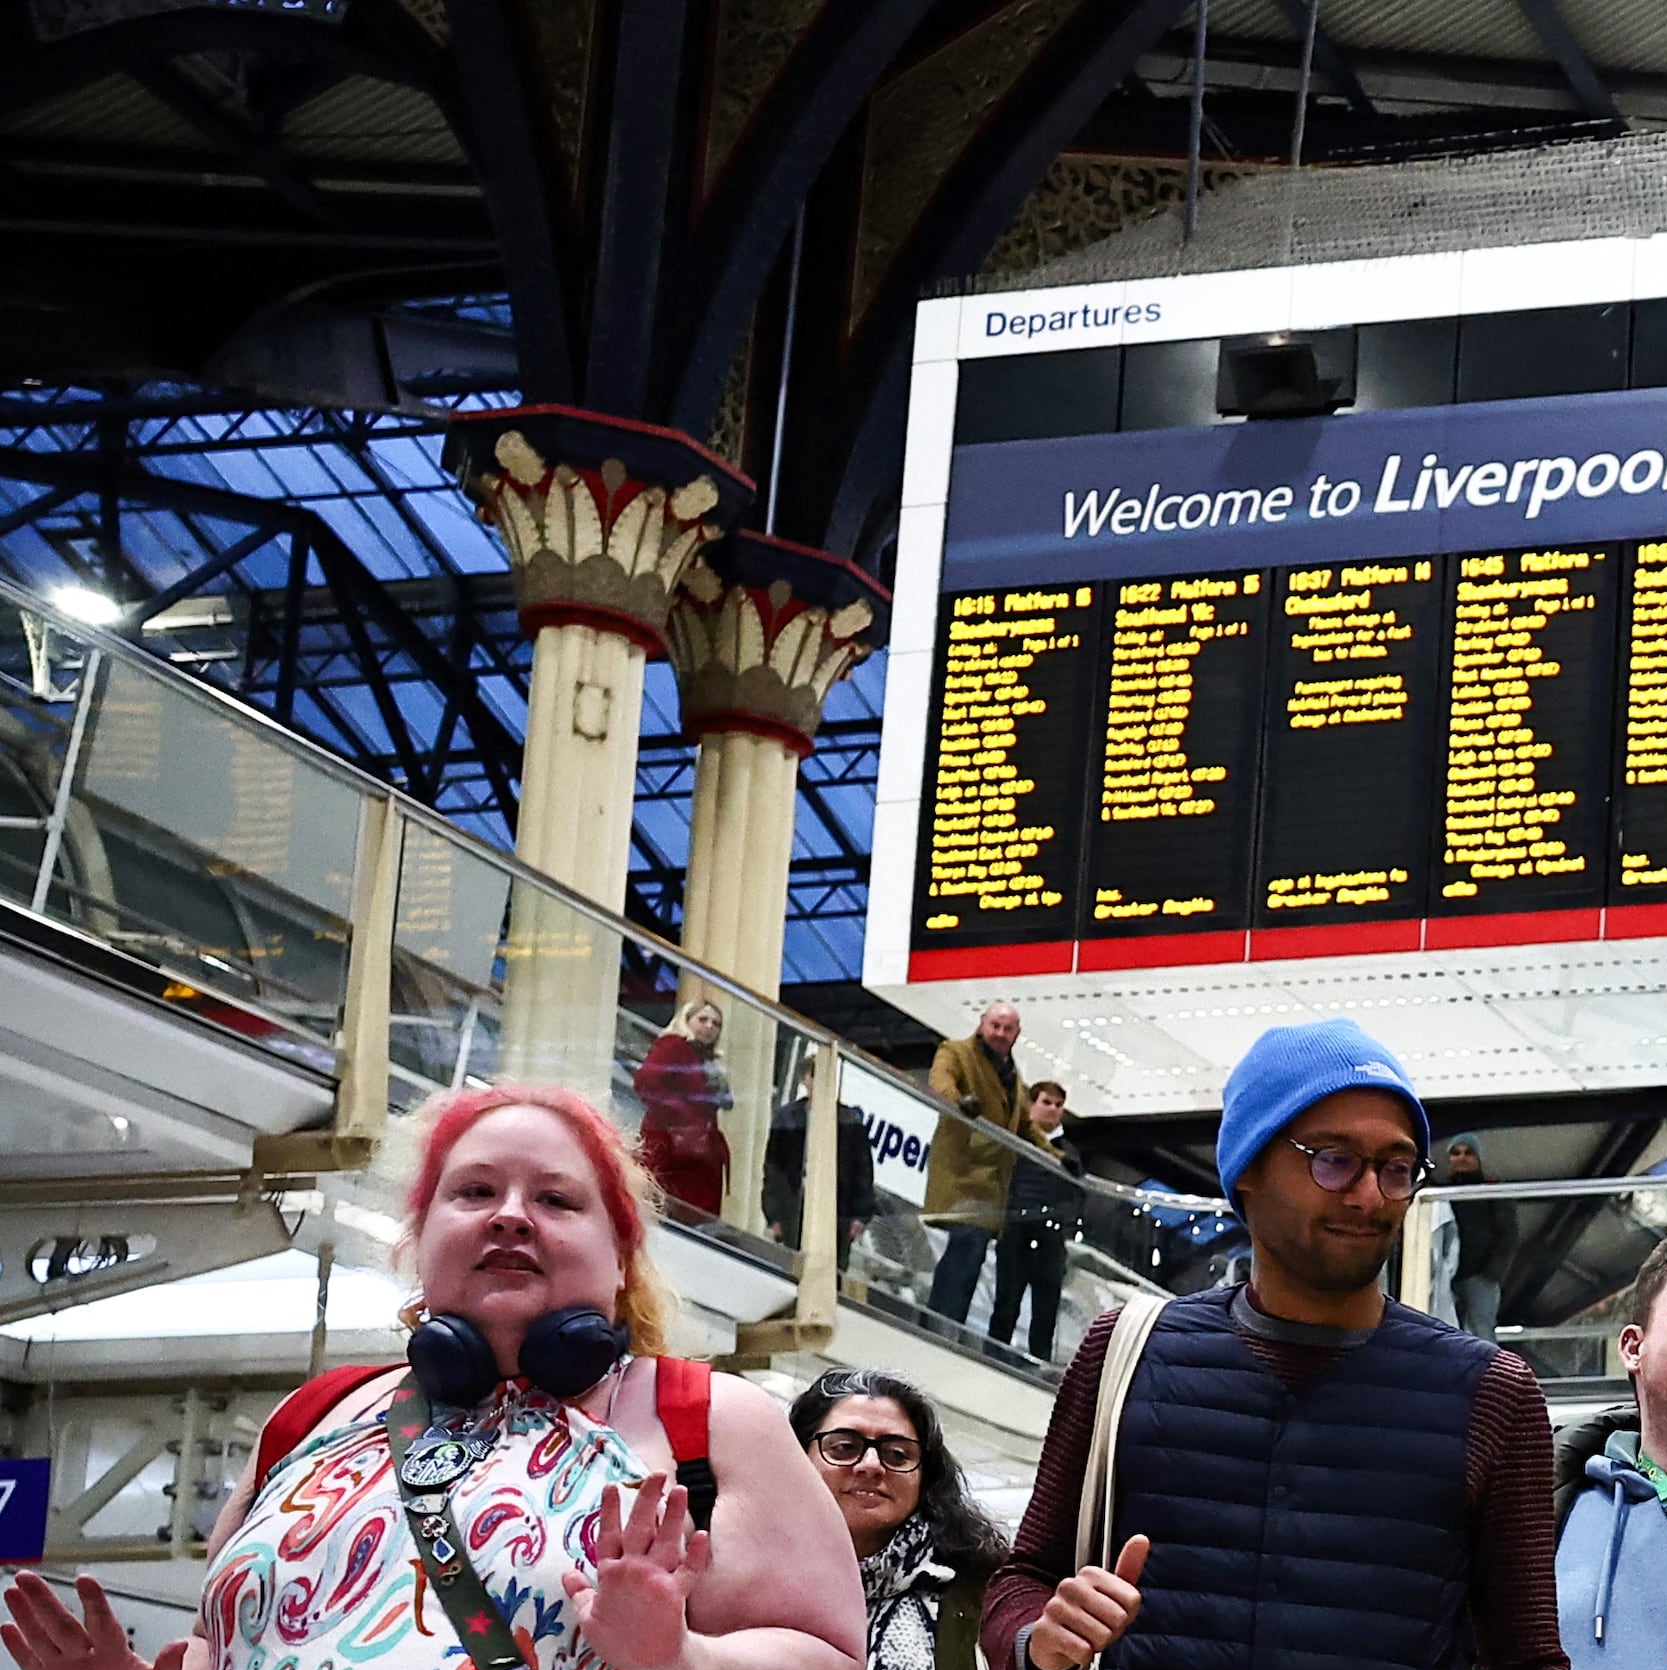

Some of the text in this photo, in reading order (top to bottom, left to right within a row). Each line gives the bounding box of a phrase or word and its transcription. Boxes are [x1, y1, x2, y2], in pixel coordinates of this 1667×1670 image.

[986, 302, 1162, 338] Departures
[1062, 483, 1294, 539] Welcome
[1309, 474, 1361, 519] to
[1521, 551, 1589, 572] Platform
[1341, 565, 1407, 586] Platform
[1171, 579, 1235, 599] Platform
[1005, 592, 1069, 612] Platform
